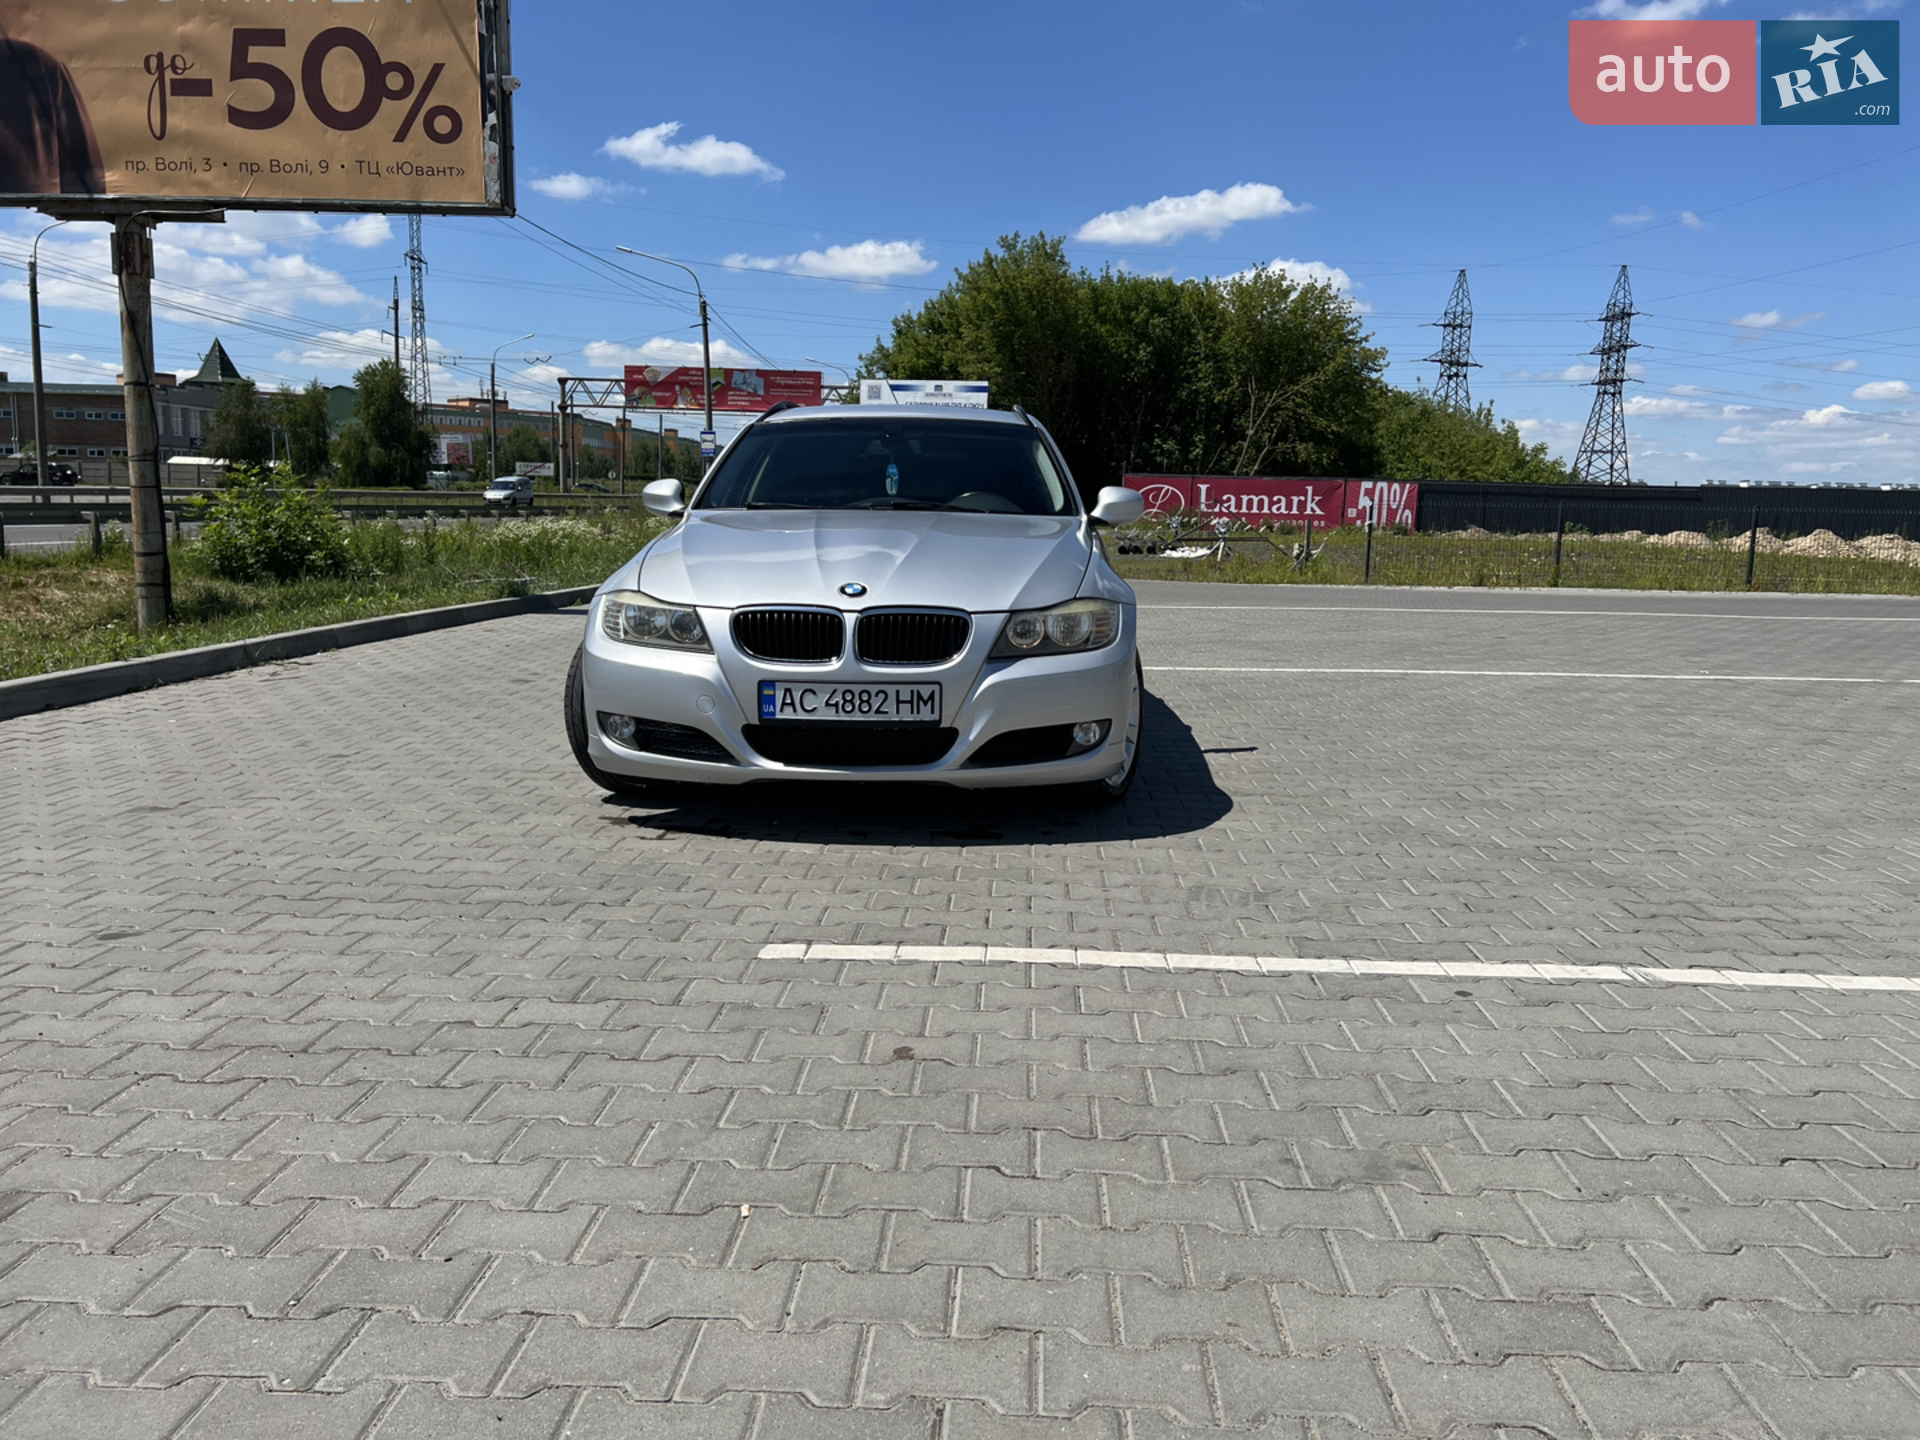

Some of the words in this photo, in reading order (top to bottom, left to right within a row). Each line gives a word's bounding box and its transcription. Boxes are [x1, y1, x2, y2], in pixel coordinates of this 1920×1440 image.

[170, 26, 463, 145] -50%
[125, 160, 150, 174] пр.
[155, 157, 197, 174] Волі,
[202, 157, 213, 172] 3
[239, 162, 264, 176] пр.
[270, 158, 313, 176] Волі,
[318, 159, 329, 174] 9
[355, 160, 381, 177] ТЦ
[385, 161, 466, 177] «Ювант»
[1197, 483, 1325, 516] Lamark
[763, 704, 775, 713] UA
[779, 687, 818, 714] AC
[824, 688, 889, 715] 4882
[895, 688, 936, 715] HM
